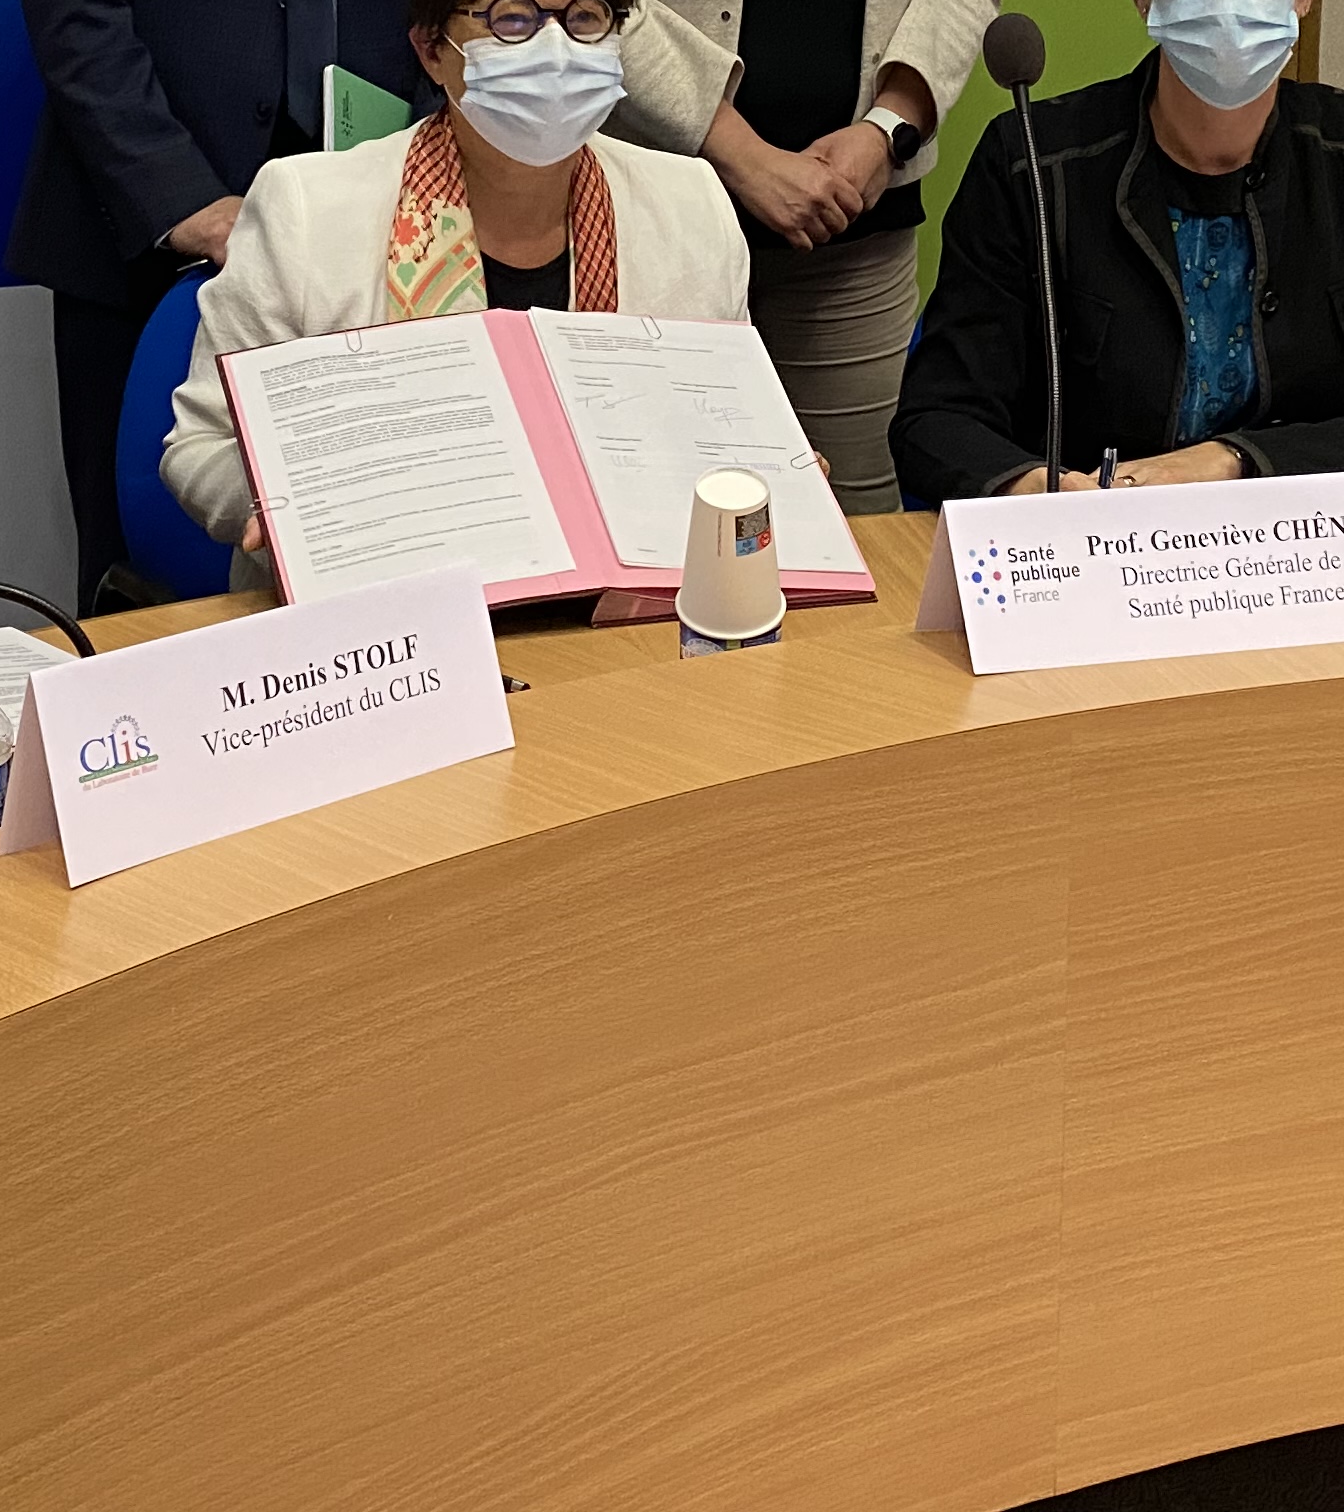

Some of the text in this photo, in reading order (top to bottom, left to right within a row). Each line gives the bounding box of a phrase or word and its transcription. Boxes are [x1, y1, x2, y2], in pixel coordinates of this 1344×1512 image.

[1007, 543, 1055, 563] Santé
[1085, 532, 1143, 557] Prof.
[1150, 524, 1266, 552] Geneviève
[1011, 563, 1081, 586] publique
[1120, 550, 1342, 587] Directrice Générale de
[1013, 589, 1060, 604] France
[1128, 594, 1184, 619] Santé
[1188, 589, 1275, 619] publique
[220, 633, 418, 713] M. Denis STOLF
[201, 668, 441, 756] Vice-président du CLIS
[80, 730, 151, 773] Clis
